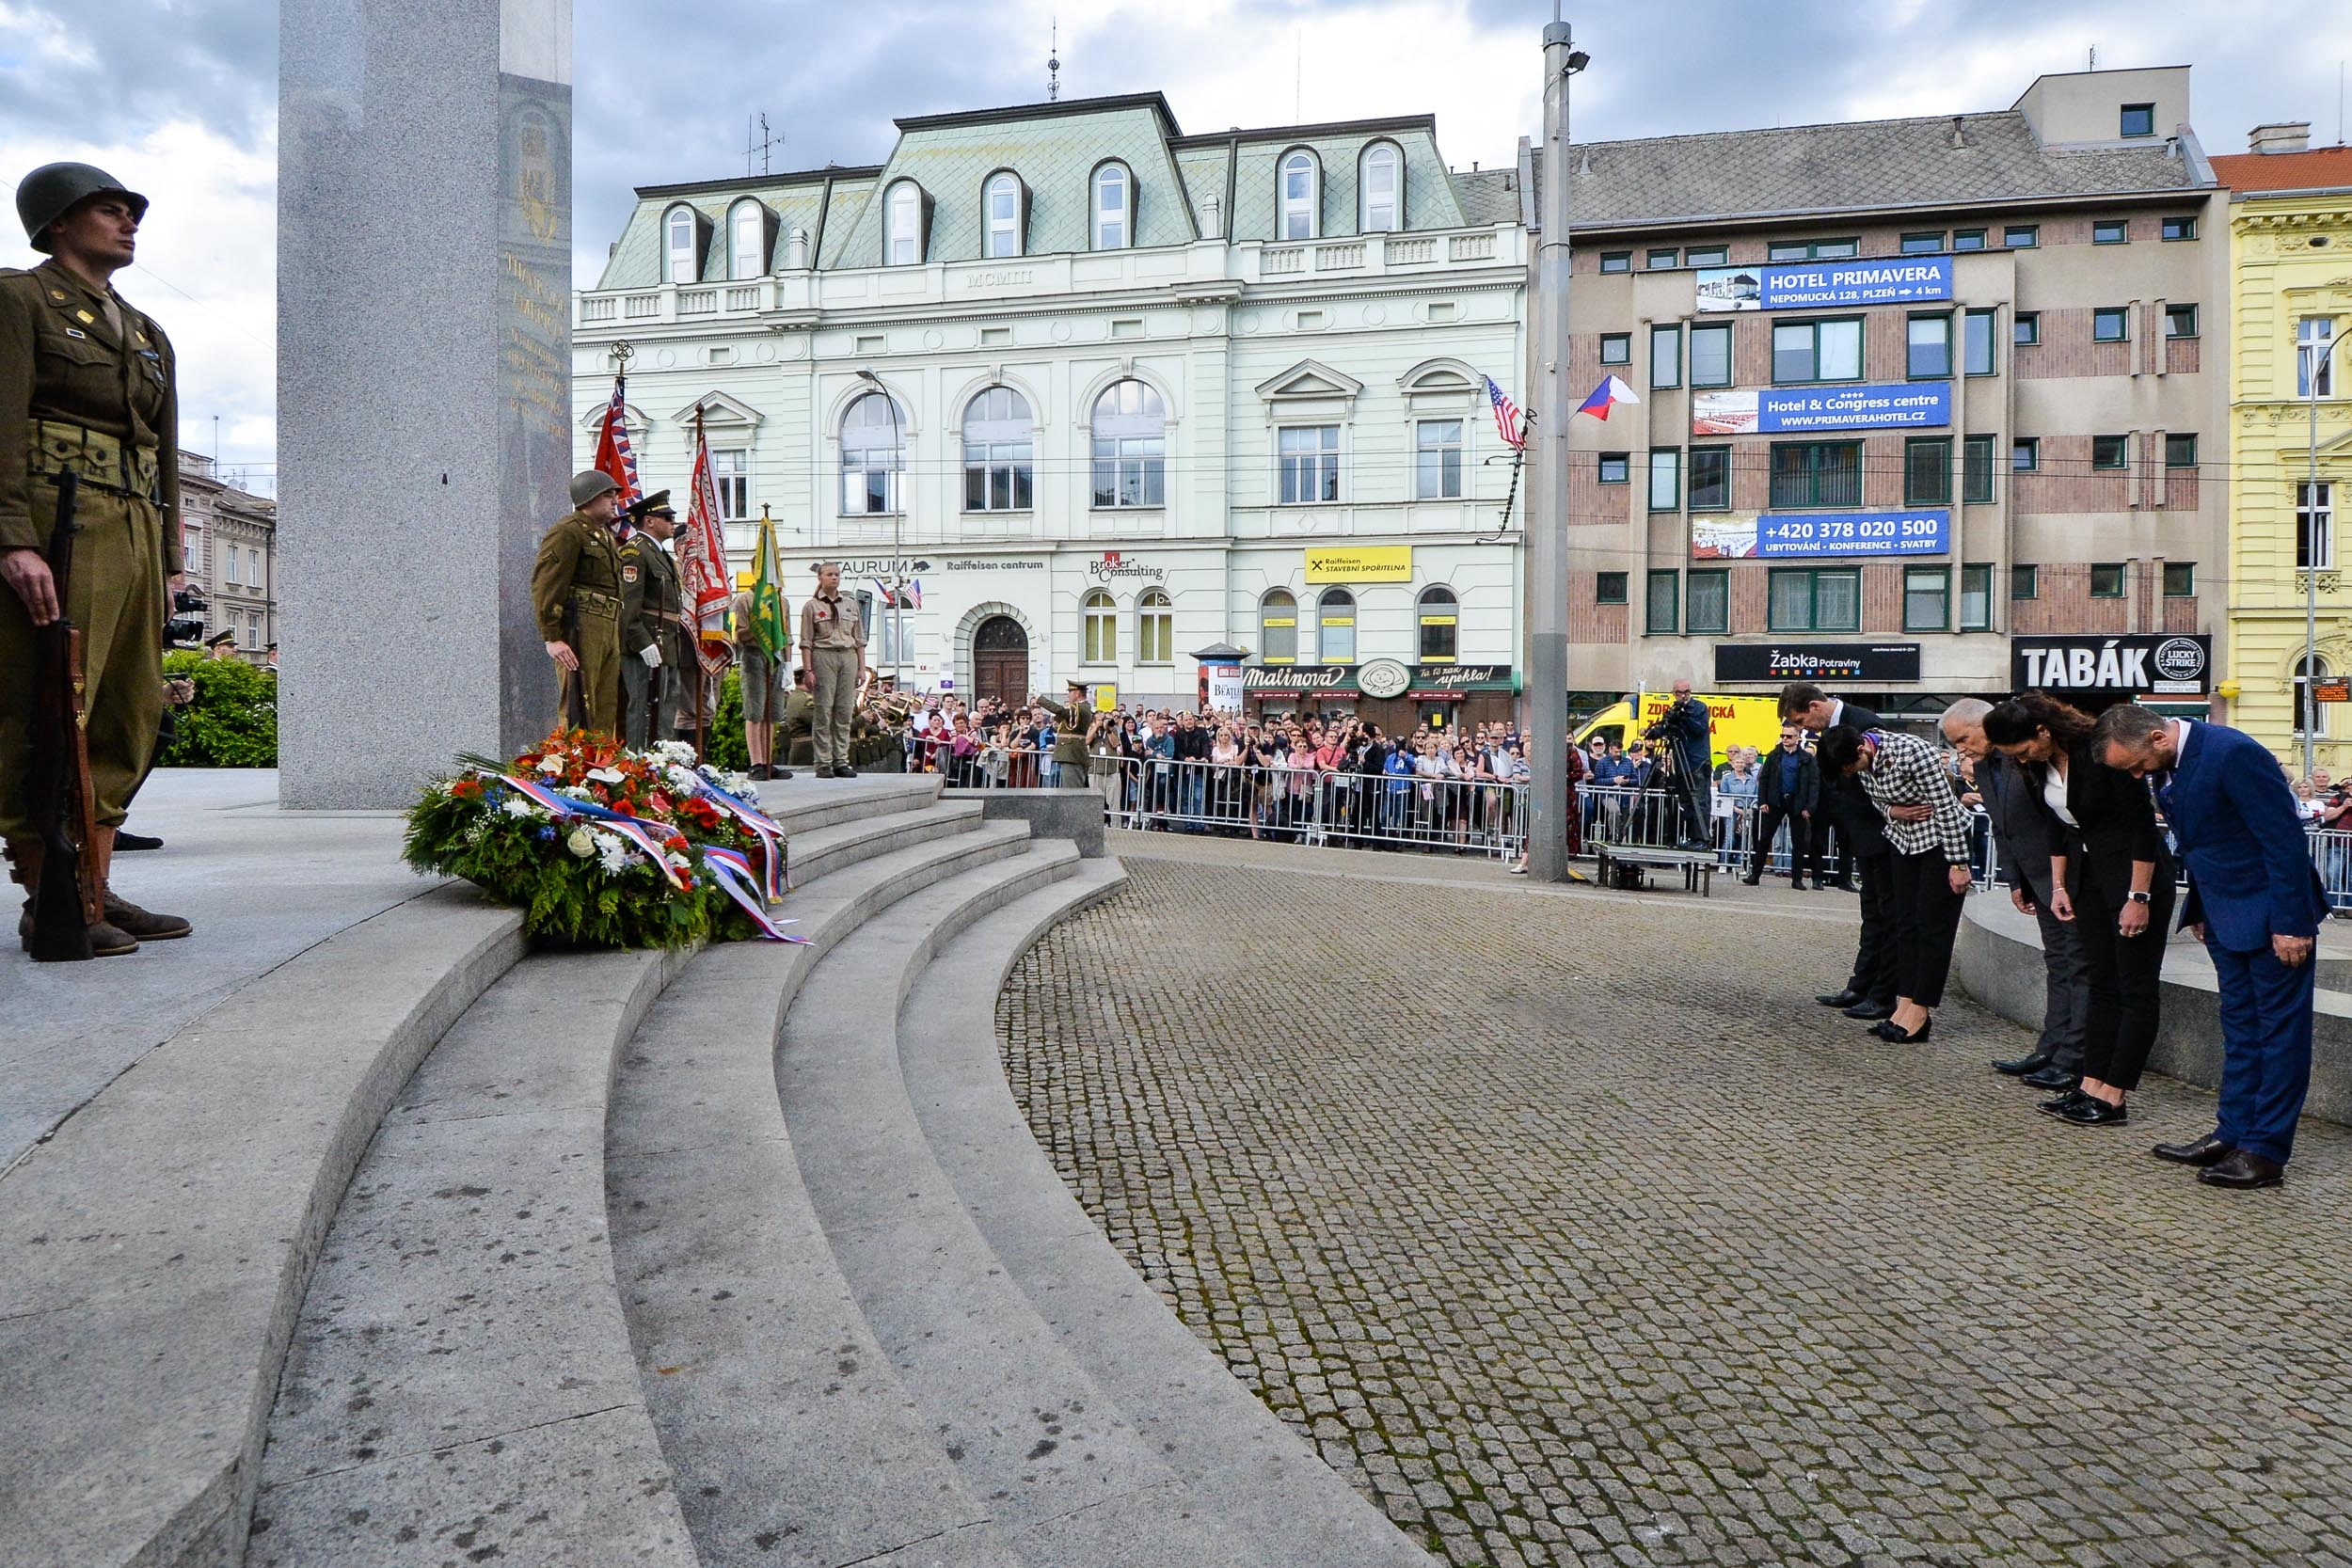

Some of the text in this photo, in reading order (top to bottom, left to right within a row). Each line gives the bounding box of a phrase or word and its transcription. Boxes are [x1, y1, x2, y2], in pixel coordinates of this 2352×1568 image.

[1770, 265, 1941, 290] HOTEL PRIMAVERA
[1770, 285, 1942, 303] NEPOMUCKÁ 128, PLZEŇ 4 km
[1768, 395, 1939, 412] Hotel & Congress centre
[1781, 412, 1927, 426] WWW.PRIMAVERAHOTEL.CZ
[1766, 519, 1938, 539] +420 378 020 500
[1766, 539, 1938, 551] UBYTOVÁNÍ KONFERENCE SVATBY
[946, 561, 1043, 571] Raiffeisen centrum
[1099, 564, 1163, 582] Consulting
[1771, 650, 1861, 669] Žabka Potraviny
[2166, 658, 2196, 667] STRIKE
[2168, 650, 2196, 658] LUCKY
[2022, 640, 2150, 688] TABÁK
[1435, 666, 1494, 689] upekla!
